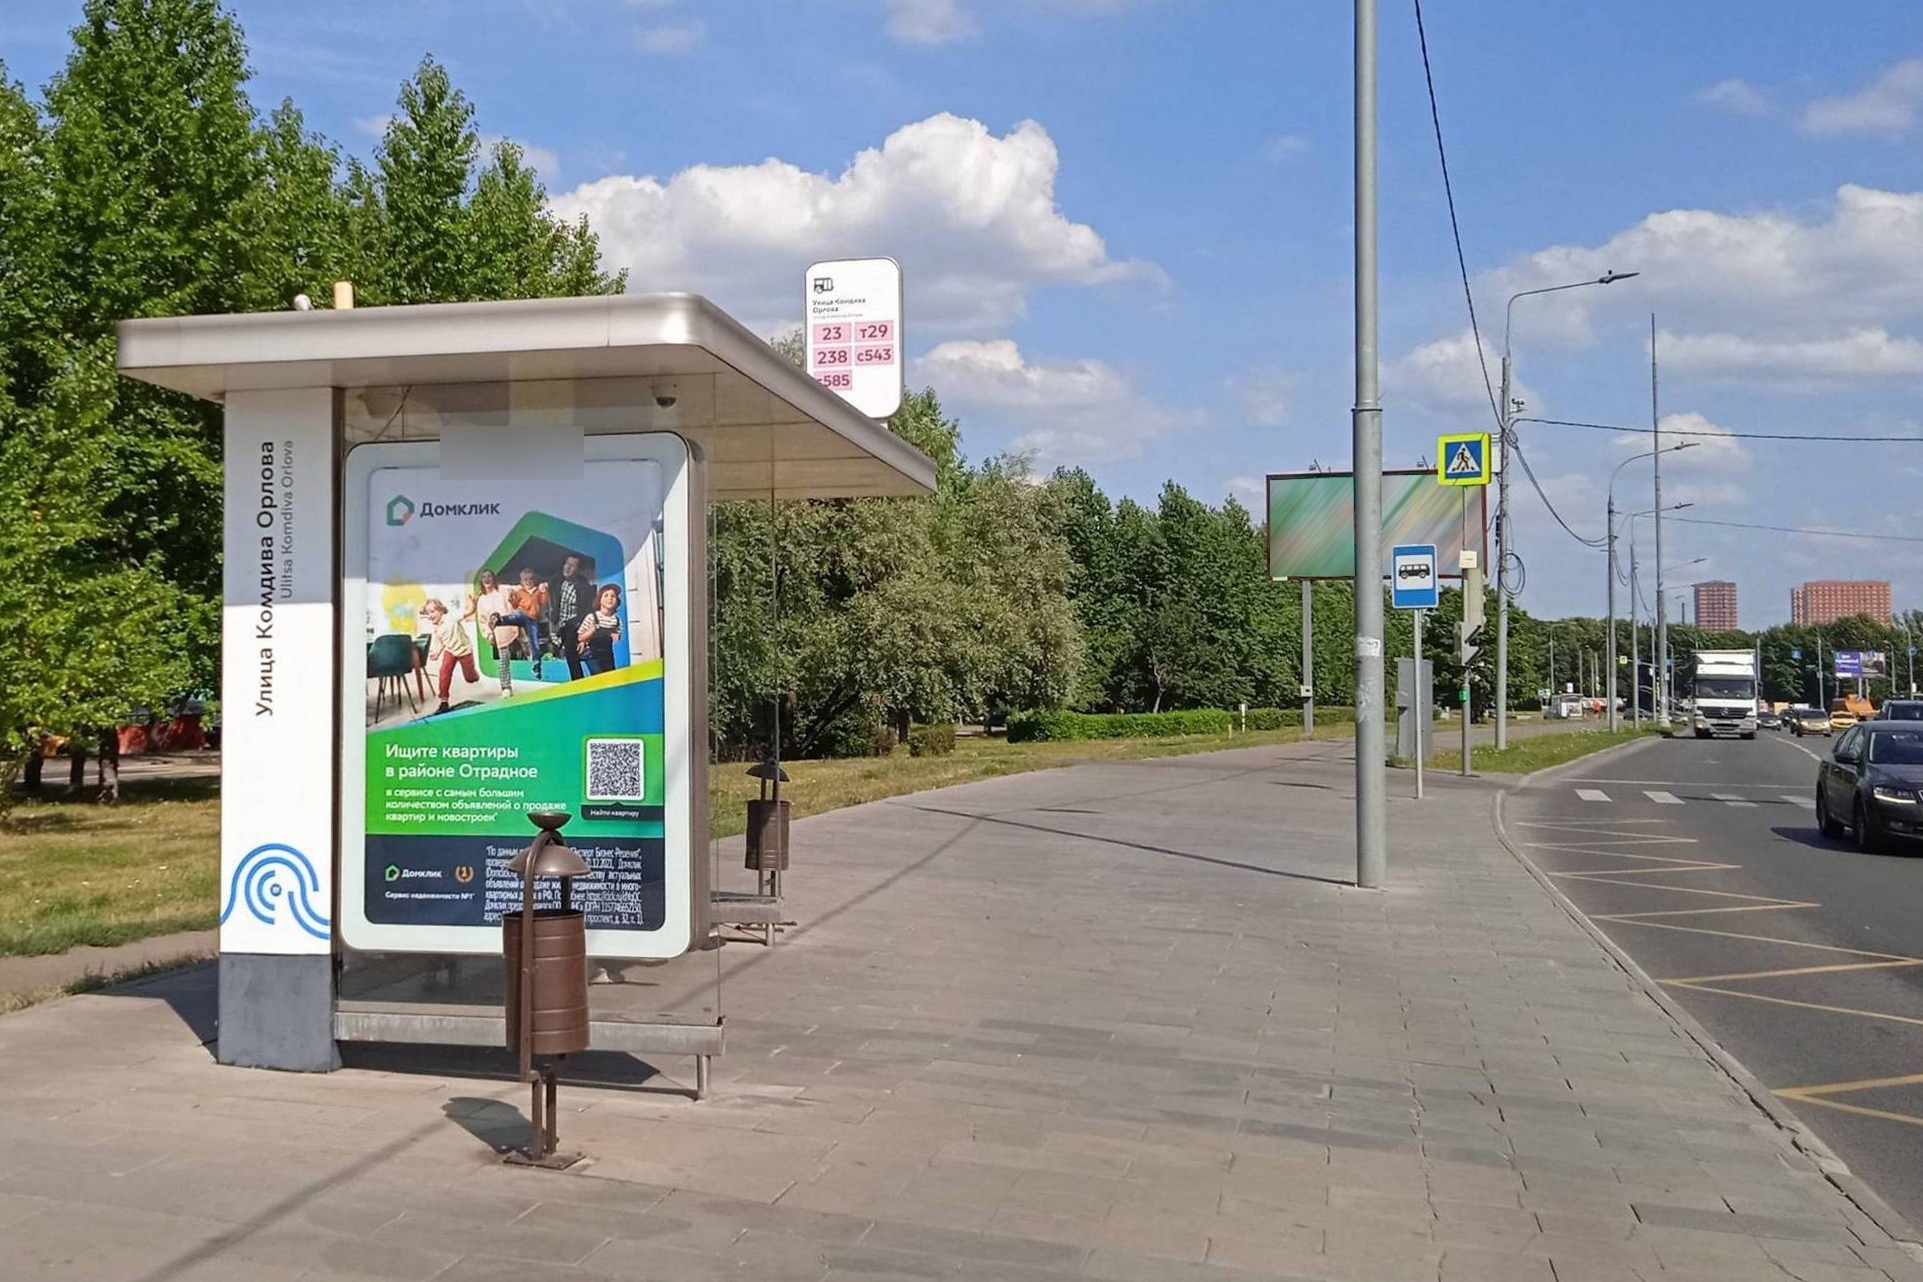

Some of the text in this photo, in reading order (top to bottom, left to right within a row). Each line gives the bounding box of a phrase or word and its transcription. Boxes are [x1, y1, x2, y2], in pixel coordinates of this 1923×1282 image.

[822, 326, 842, 340] 23
[817, 350, 848, 365] 238
[420, 502, 500, 518] Домклик
[280, 440, 294, 599] Ulitsa Komdiva Orlova
[256, 441, 277, 717] Улица Комдива Орлова
[386, 744, 518, 761] Ищите квартиры
[385, 763, 538, 781] в районе Отрадное
[394, 790, 434, 798] сервисе
[451, 800, 511, 809] объявлений
[523, 802, 566, 812] продаже
[386, 814, 426, 823] квартир
[401, 869, 442, 878] Домклик
